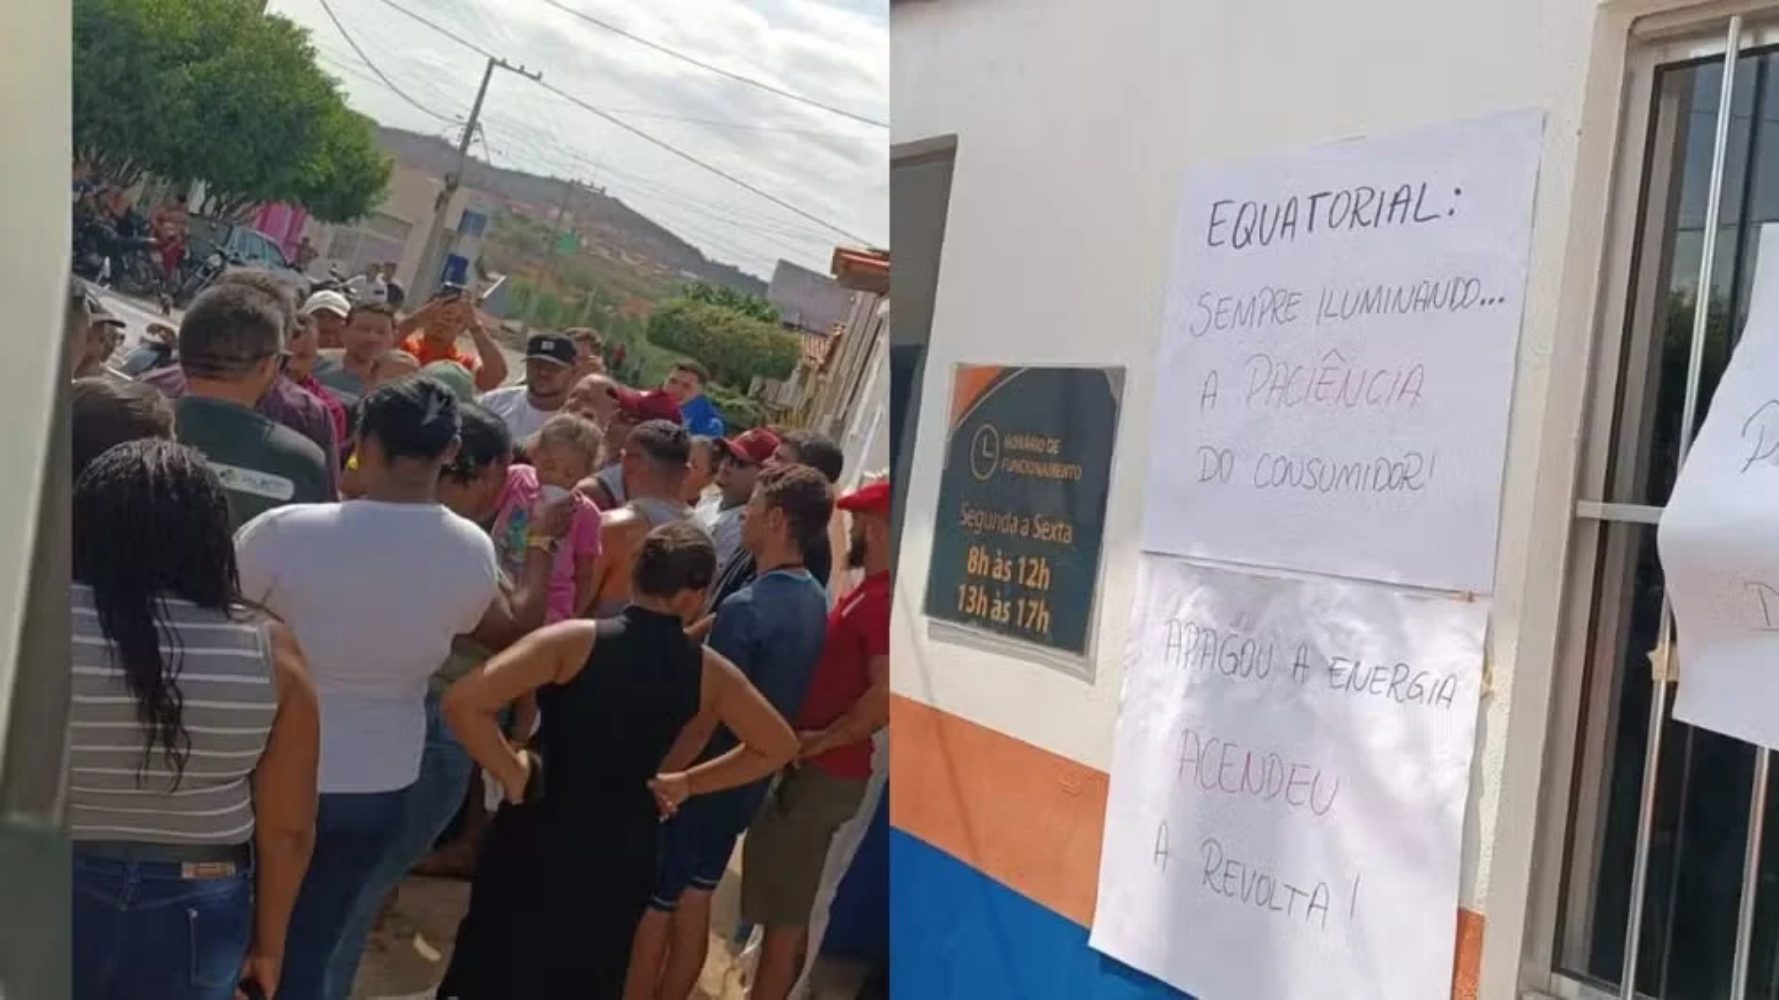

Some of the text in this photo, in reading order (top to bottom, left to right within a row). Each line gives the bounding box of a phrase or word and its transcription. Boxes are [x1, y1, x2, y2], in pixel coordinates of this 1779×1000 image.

[1207, 182, 1462, 249] EQUATORIAL:
[1189, 277, 1505, 338] SEMPRE ILUMINANDO...
[1200, 348, 1425, 412] A PACIÊNCIA
[1001, 457, 1082, 481] FUNCIONAMENTO
[1047, 438, 1061, 455] DE
[1197, 445, 1234, 484] DO
[960, 503, 1073, 543] Segunda a Sexta
[967, 546, 1050, 591] 8h às 12h
[957, 584, 1049, 634] 13h às 17h
[1165, 618, 1458, 709] APAGOU A ENERGIA
[1178, 729, 1338, 816] ACENDEU
[1154, 819, 1169, 872] A
